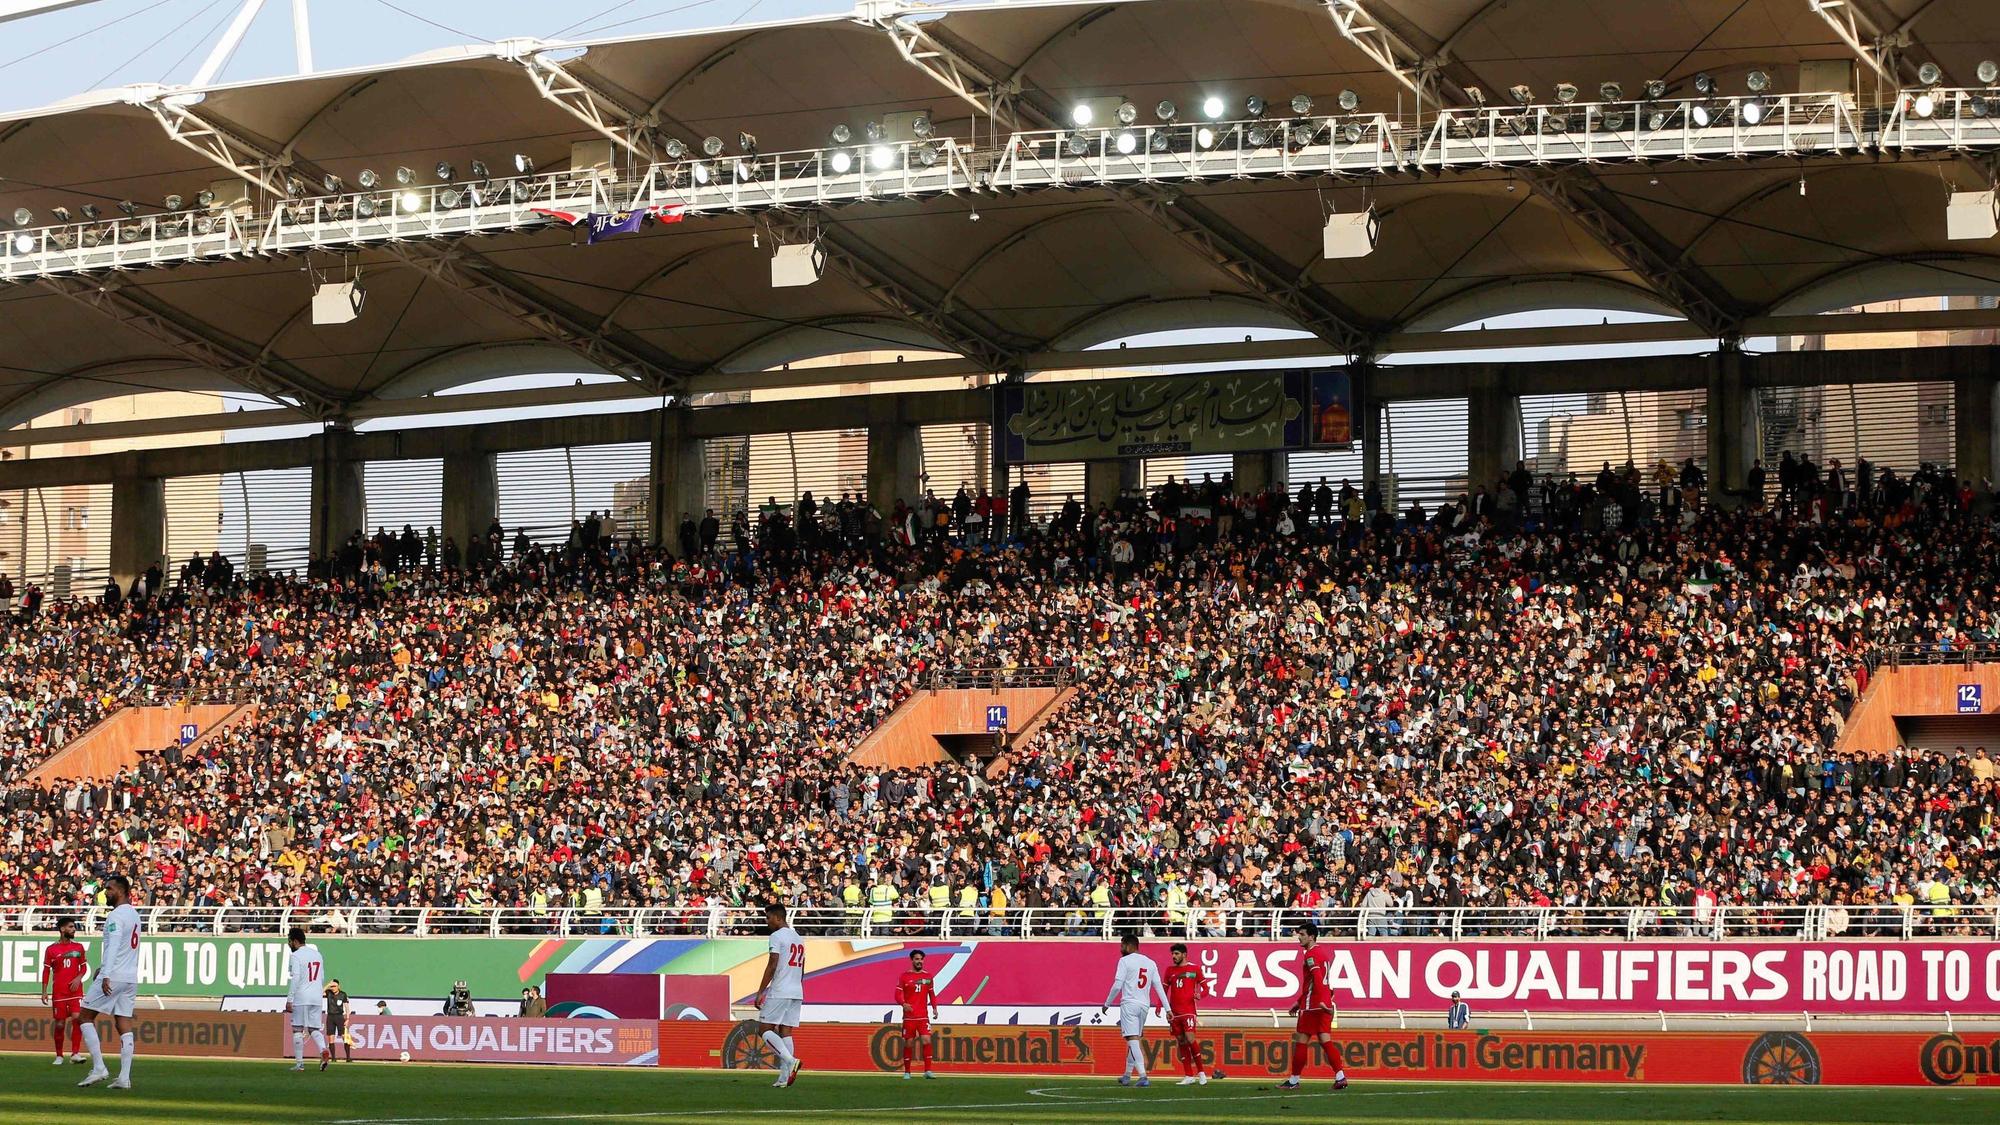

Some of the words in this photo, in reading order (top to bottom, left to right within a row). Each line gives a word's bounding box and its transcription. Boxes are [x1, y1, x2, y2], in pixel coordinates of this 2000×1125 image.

[592, 214, 624, 234] AFC
[130, 924, 139, 950] 6
[63, 958, 72, 968] 10
[183, 942, 217, 984] TO
[227, 942, 318, 989] QATA
[788, 943, 805, 967] 22
[307, 961, 321, 982] 17
[1137, 968, 1148, 990] 5
[1176, 978, 1184, 988] 16
[1223, 949, 1411, 998] ASAN
[1424, 948, 1789, 1000] QUALIFIERS
[1803, 949, 1907, 1001] ROAD
[1922, 949, 1971, 1001] TO
[131, 1018, 247, 1052] ermany
[429, 1025, 613, 1053] QUALIFIERS
[619, 1028, 640, 1039] ROAD
[642, 1029, 652, 1039] TO
[619, 1040, 651, 1053] QATAR
[1435, 1035, 1466, 1068] in
[1476, 1035, 1644, 1078] Germany
